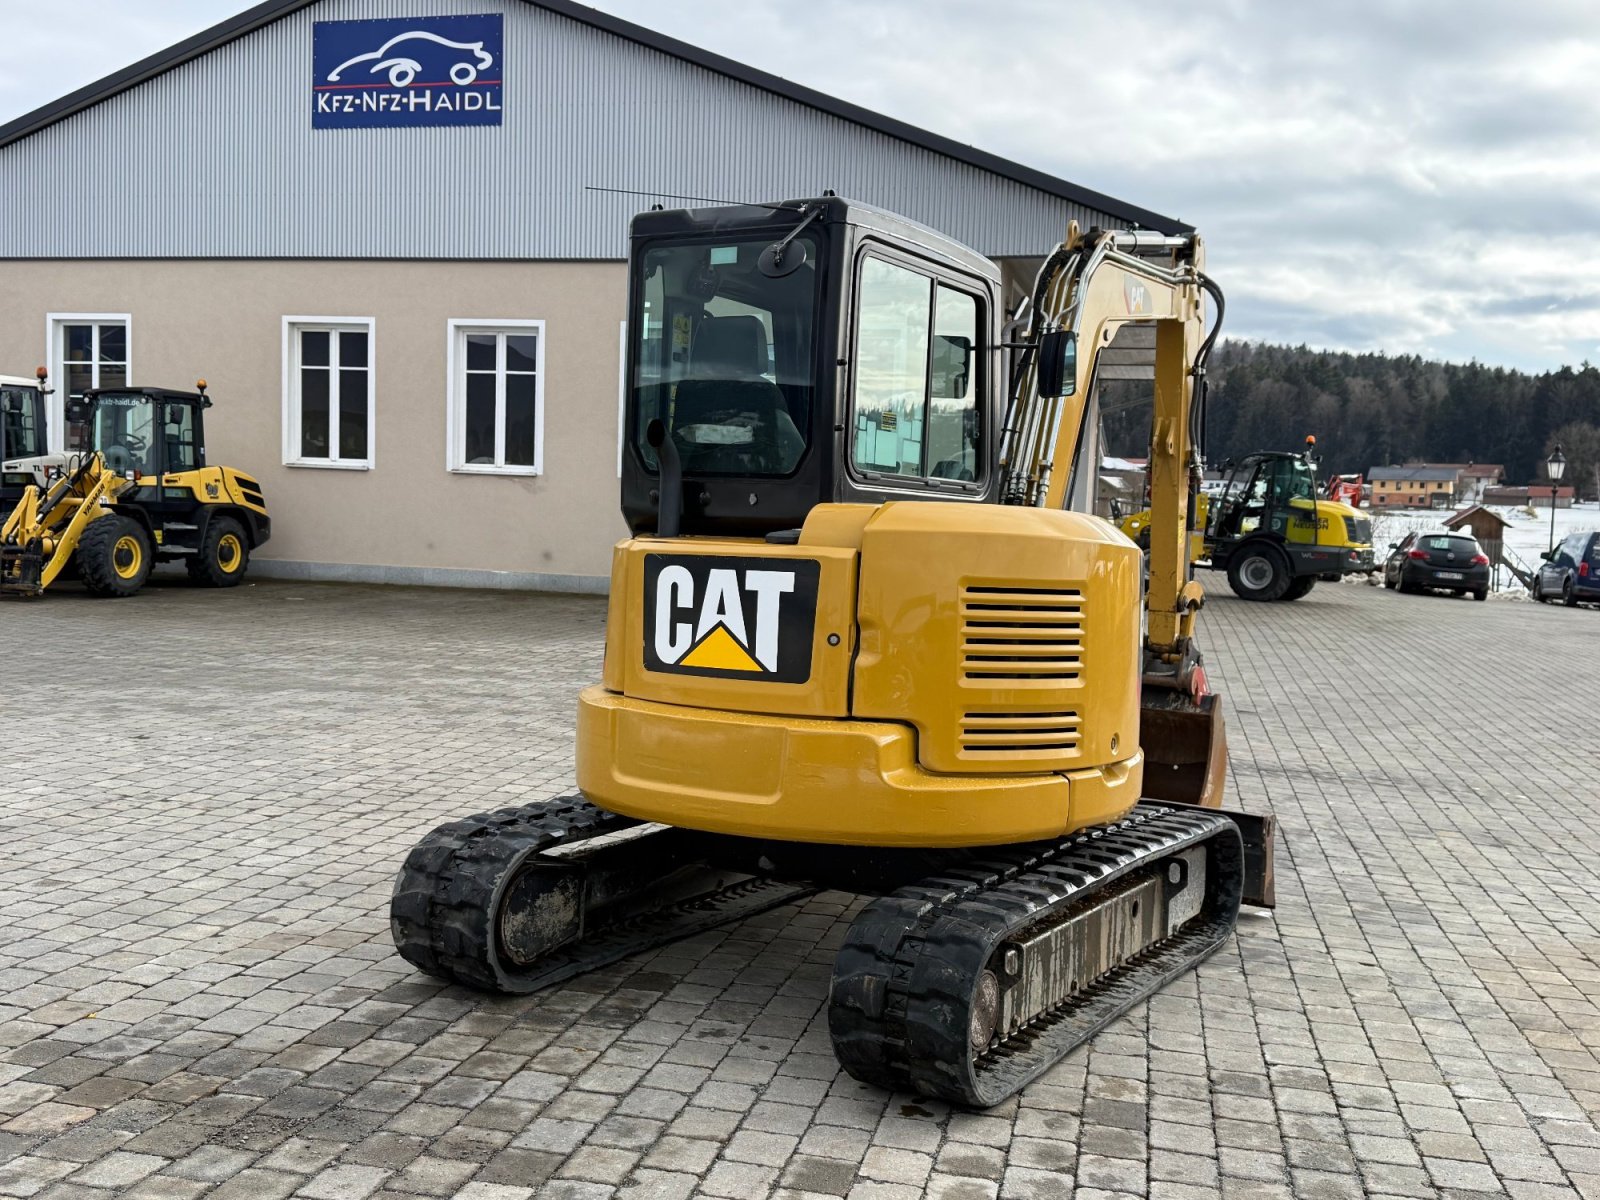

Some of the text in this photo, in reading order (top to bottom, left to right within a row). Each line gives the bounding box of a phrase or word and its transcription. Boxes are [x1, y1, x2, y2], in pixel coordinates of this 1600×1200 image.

[1131, 285, 1145, 312] CAT
[82, 483, 106, 516] YANMAR
[654, 564, 796, 673] CAT
